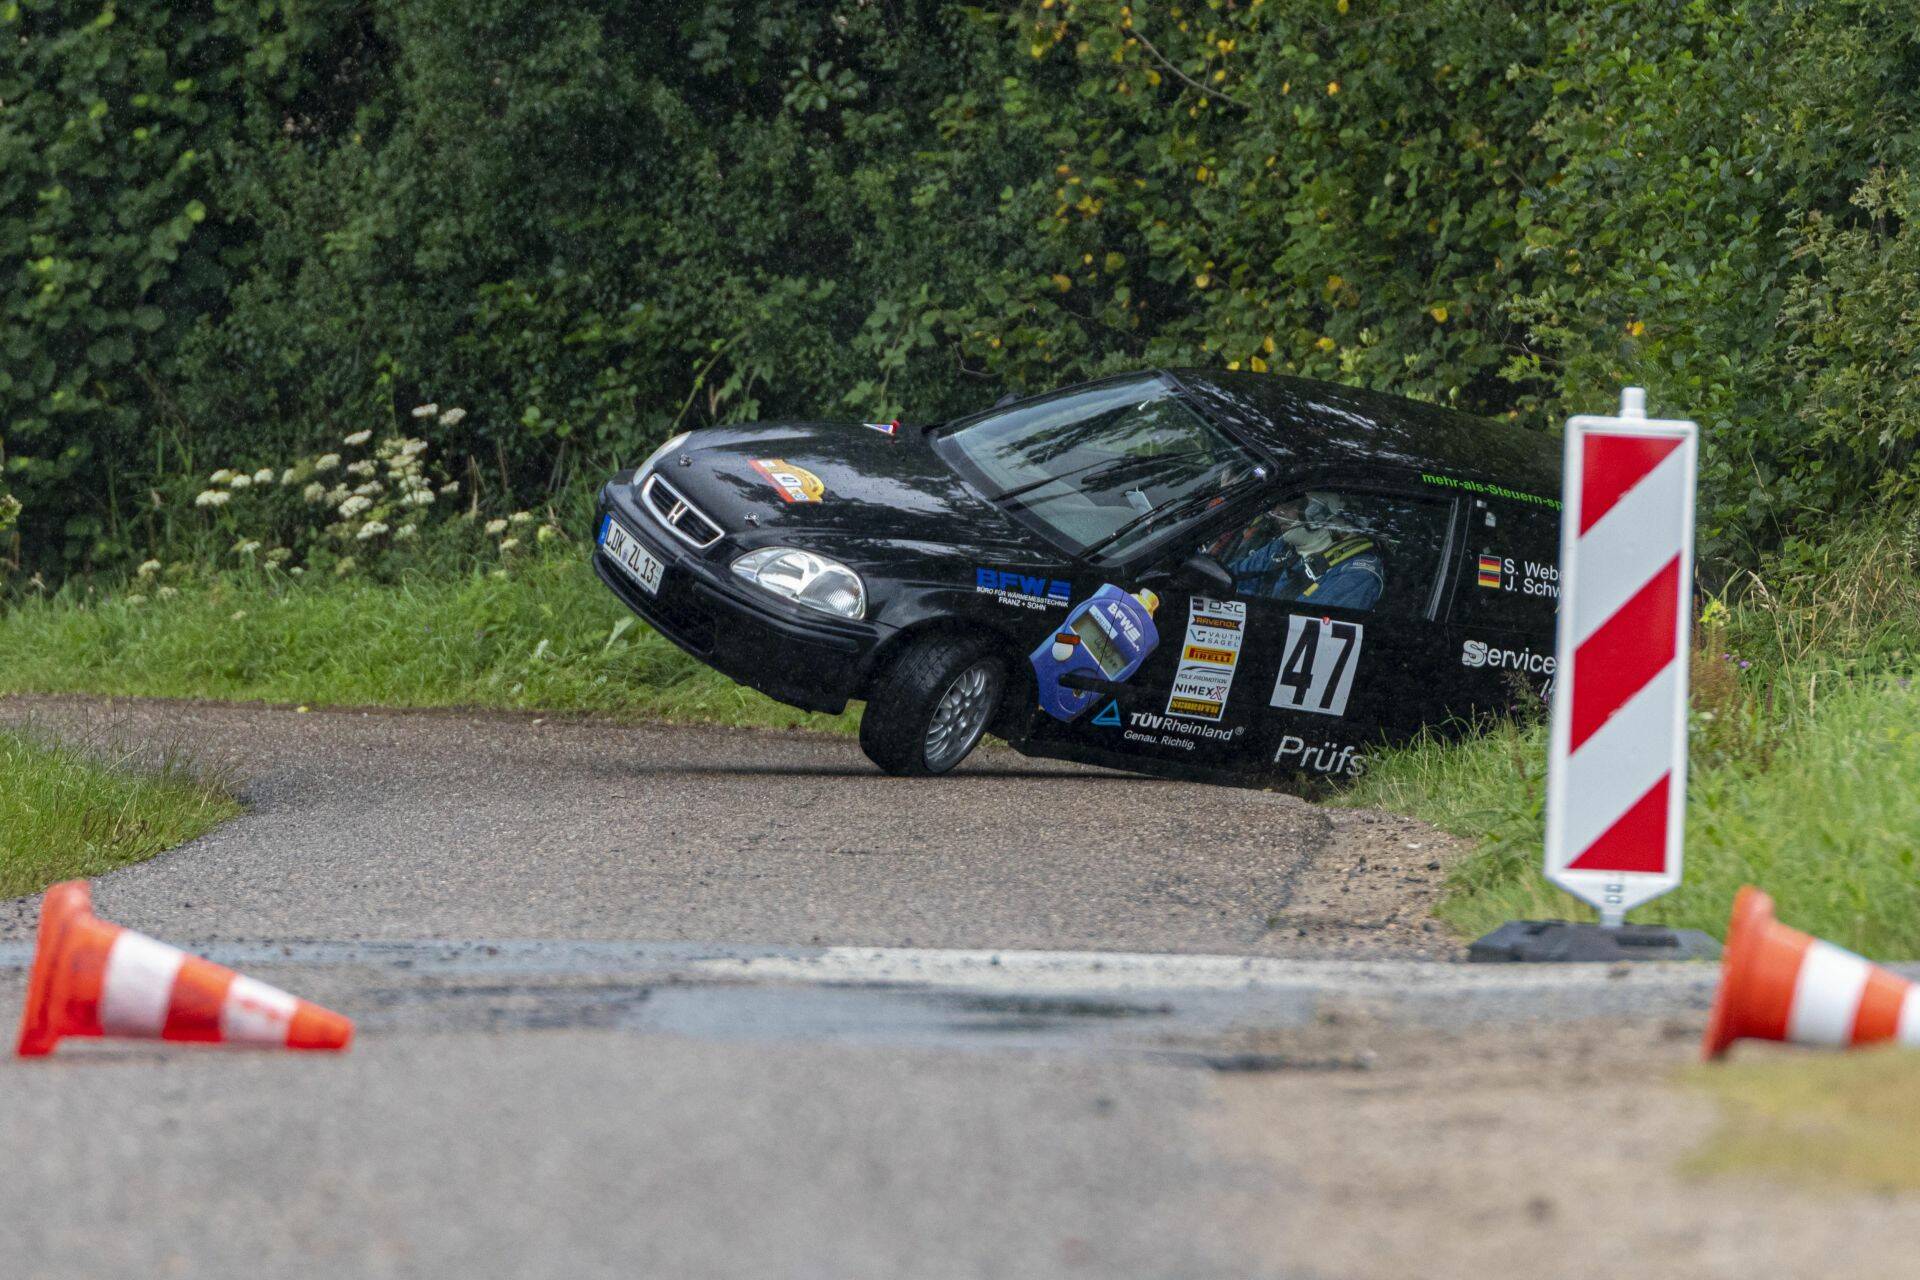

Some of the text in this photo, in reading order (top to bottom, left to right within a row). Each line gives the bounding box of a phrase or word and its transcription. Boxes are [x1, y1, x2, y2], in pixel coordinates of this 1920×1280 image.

[605, 522, 627, 557] LDK
[628, 543, 641, 572] ZL
[640, 556, 657, 584] 13
[1503, 558, 1519, 575] S.
[976, 567, 1046, 597] BFW
[976, 585, 994, 595] BÜRO
[994, 588, 1007, 596] FÜR
[1505, 575, 1518, 592] J.
[998, 596, 1021, 607] FRANZ
[1026, 601, 1046, 611] SOHN
[1196, 617, 1237, 628] RAVENOL
[1207, 638, 1239, 647] SAGEL
[1208, 631, 1241, 640] VAUTH
[1188, 648, 1232, 663] PIRELLI
[1280, 619, 1356, 710] 47
[1174, 683, 1227, 700] NIMEXX
[1123, 730, 1196, 751] Genau. Richtig.
